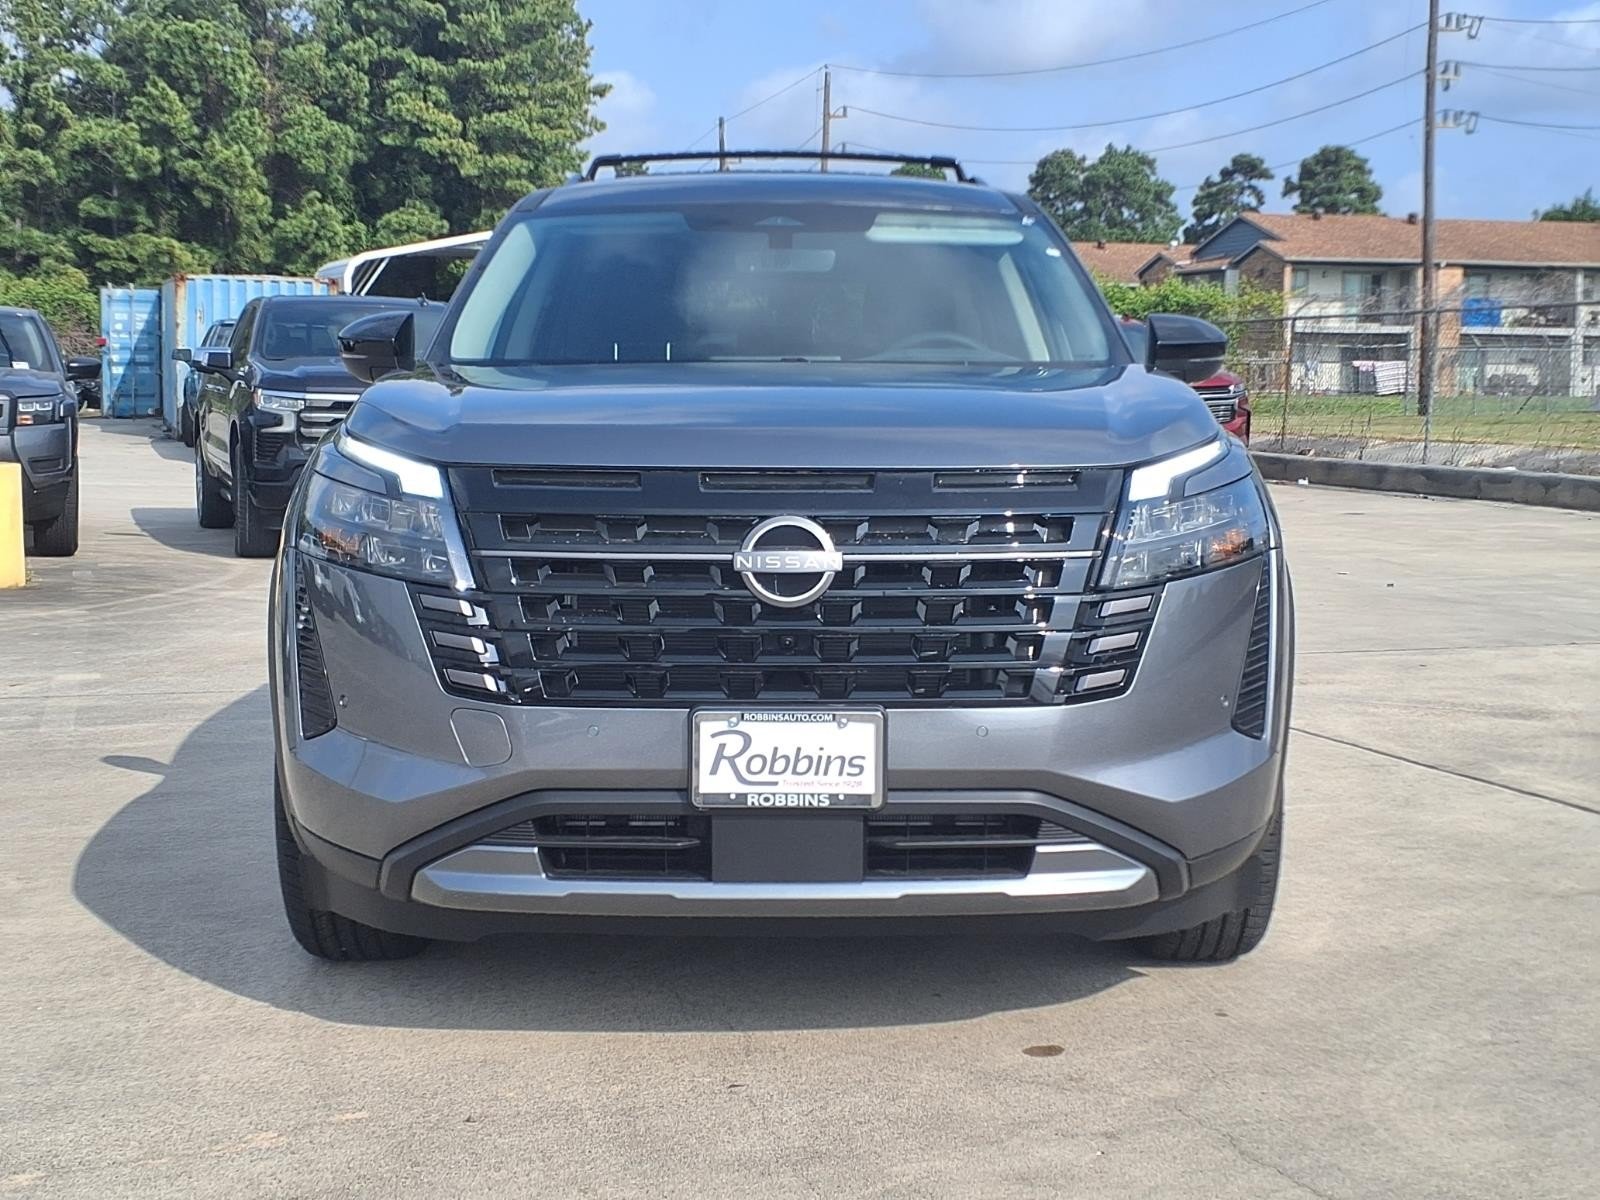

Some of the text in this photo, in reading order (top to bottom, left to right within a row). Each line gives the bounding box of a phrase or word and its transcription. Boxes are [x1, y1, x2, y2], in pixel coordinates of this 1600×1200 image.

[736, 555, 839, 569] NISSAN
[743, 713, 833, 722] ROBBINSAUTO.COM
[709, 730, 866, 786] Robbins
[747, 794, 830, 807] ROBBINS
